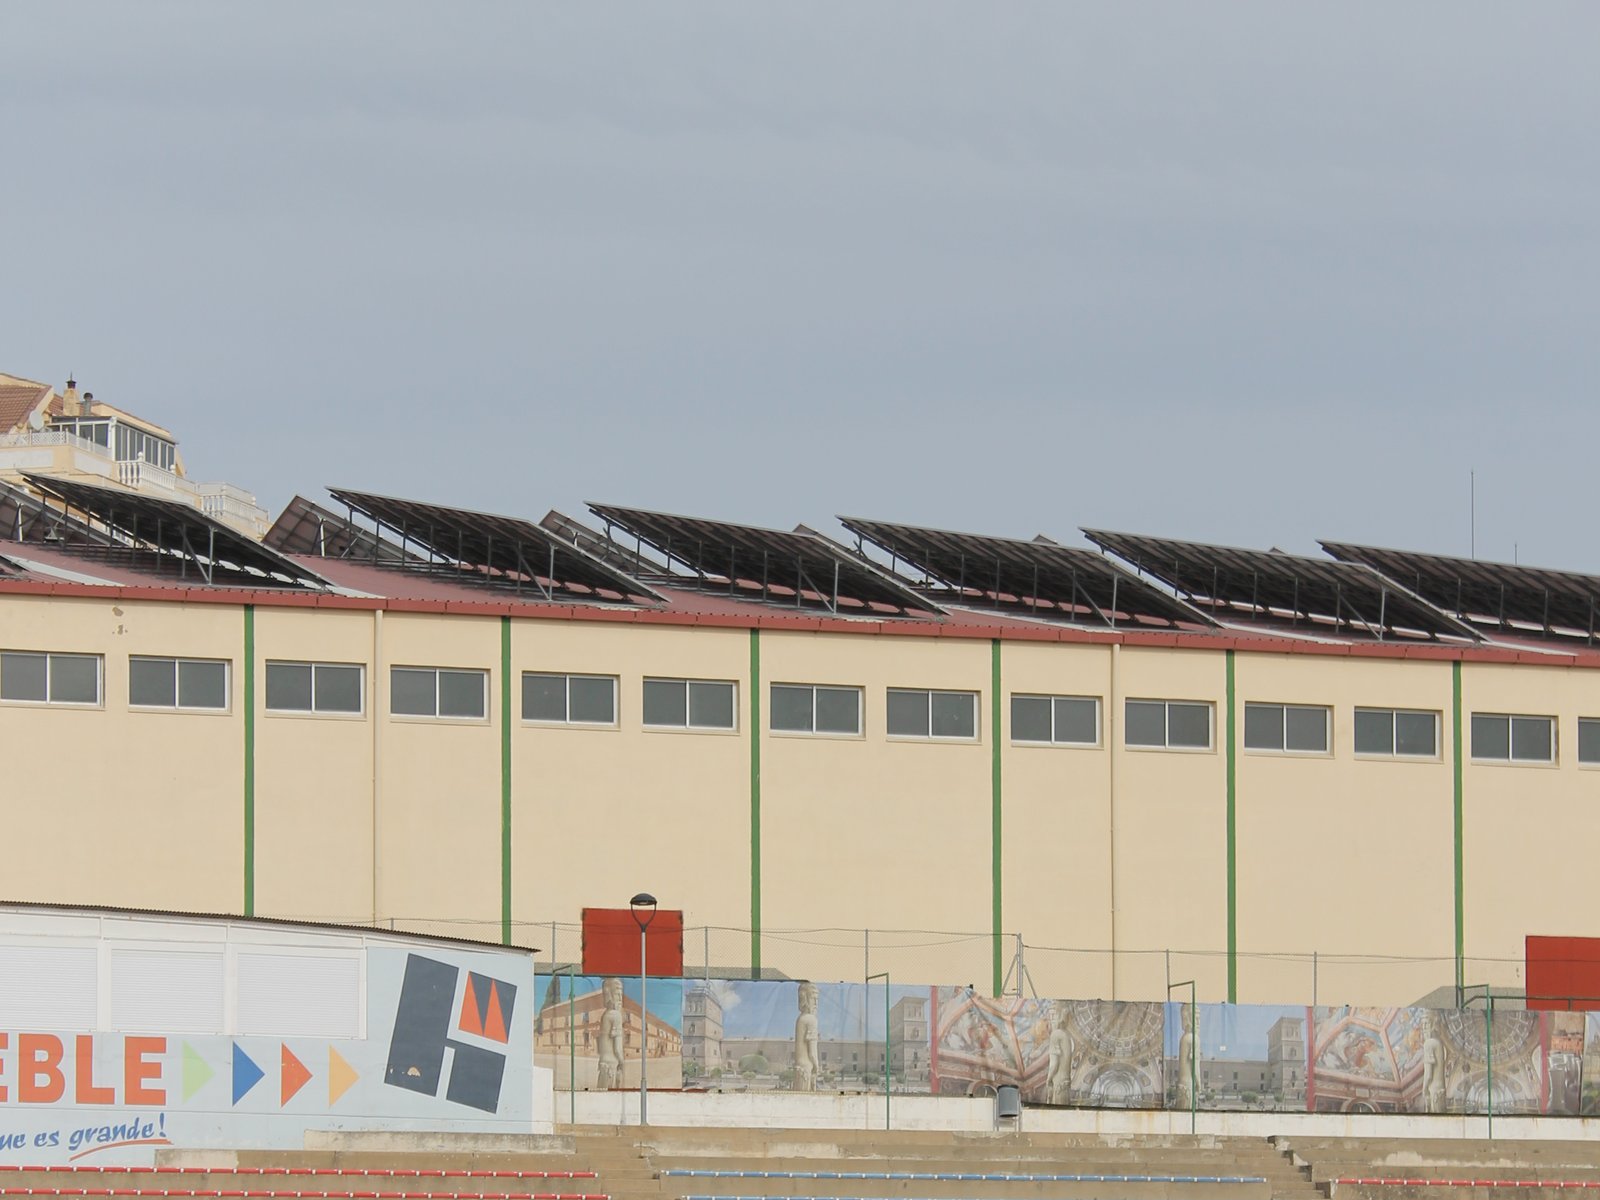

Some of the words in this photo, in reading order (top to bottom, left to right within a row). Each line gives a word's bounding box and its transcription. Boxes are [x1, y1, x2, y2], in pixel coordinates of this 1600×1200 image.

[0, 1033, 166, 1106] BLE
[34, 1130, 60, 1147] es
[68, 1112, 166, 1151] grande!
